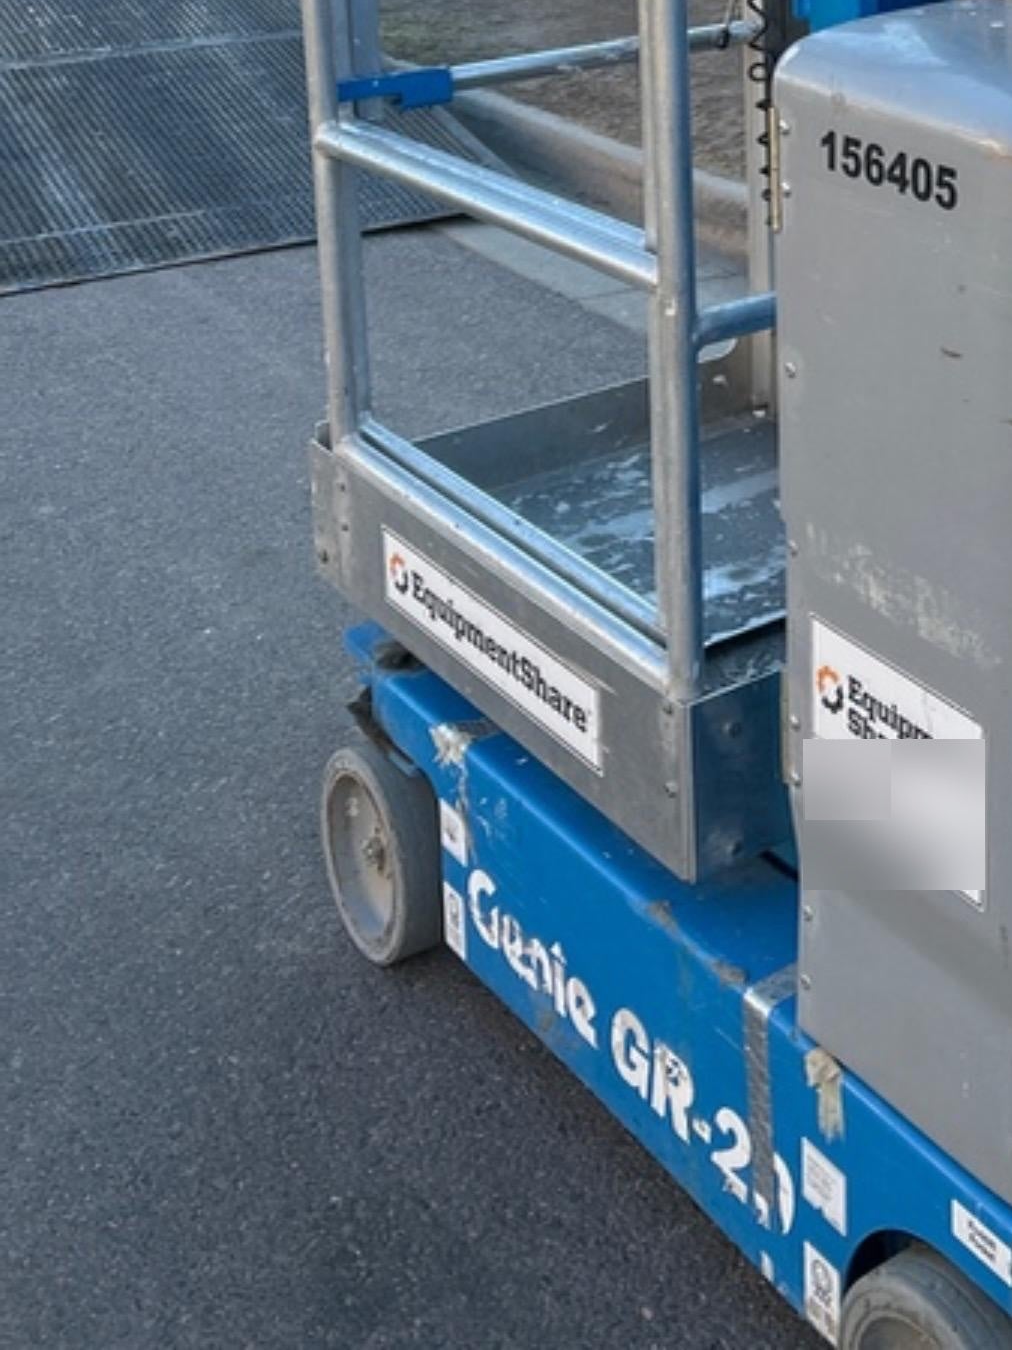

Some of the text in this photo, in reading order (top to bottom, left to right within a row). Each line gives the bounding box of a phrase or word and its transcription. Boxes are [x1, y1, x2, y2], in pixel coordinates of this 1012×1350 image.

[820, 129, 958, 211] 156405
[410, 571, 589, 734] EquipmentShare
[467, 867, 599, 1050] Genie
